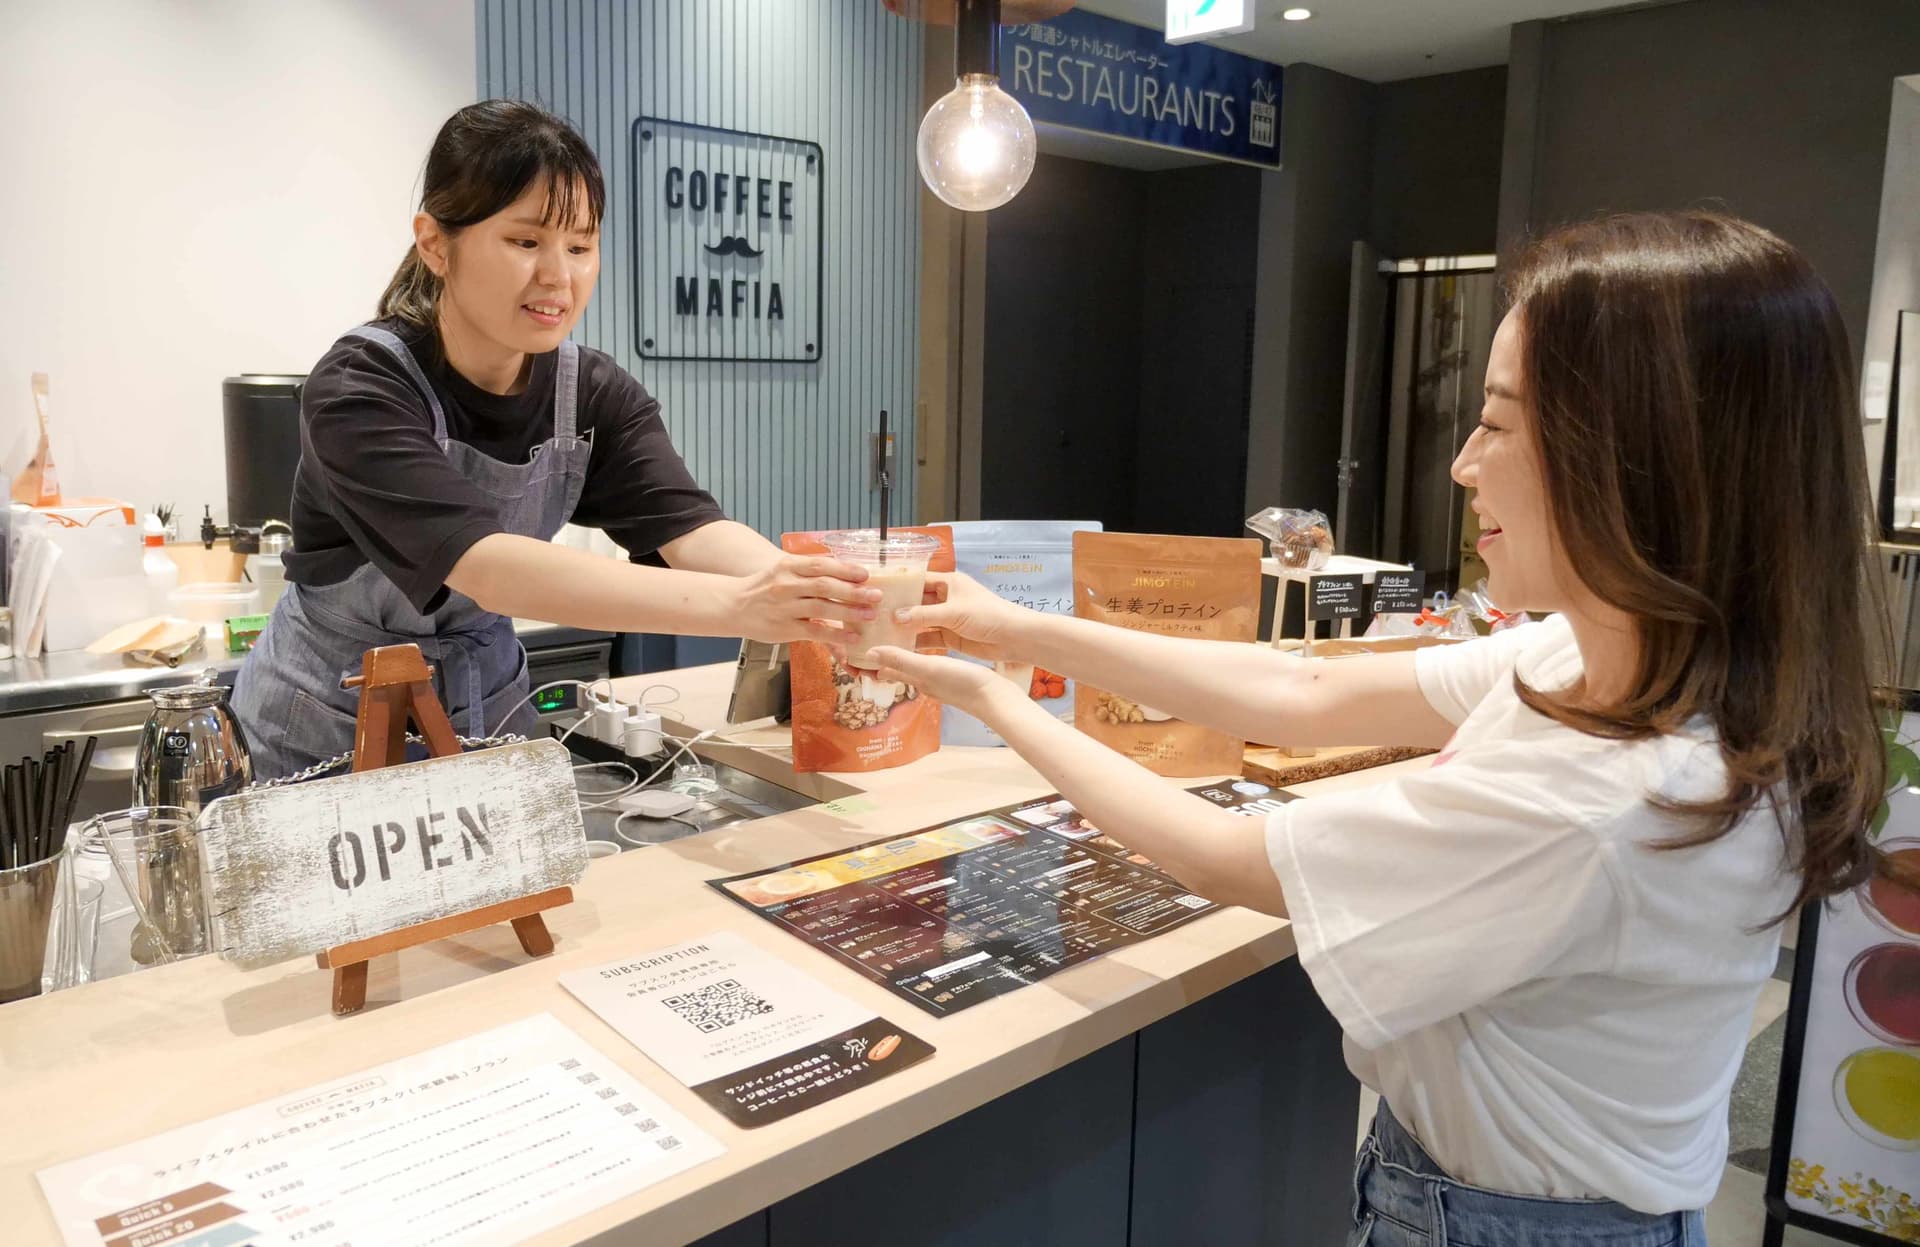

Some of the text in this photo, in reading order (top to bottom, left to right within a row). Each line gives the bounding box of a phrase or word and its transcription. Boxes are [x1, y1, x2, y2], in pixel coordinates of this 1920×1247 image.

[1013, 45, 1235, 137] RESTAURANTS
[665, 166, 793, 220] COFFEE
[676, 276, 783, 320] MAFIA
[1105, 597, 1221, 618] 生姜プロテイン
[327, 802, 495, 891] OPEN
[600, 944, 710, 979] SUBSCRIPTION
